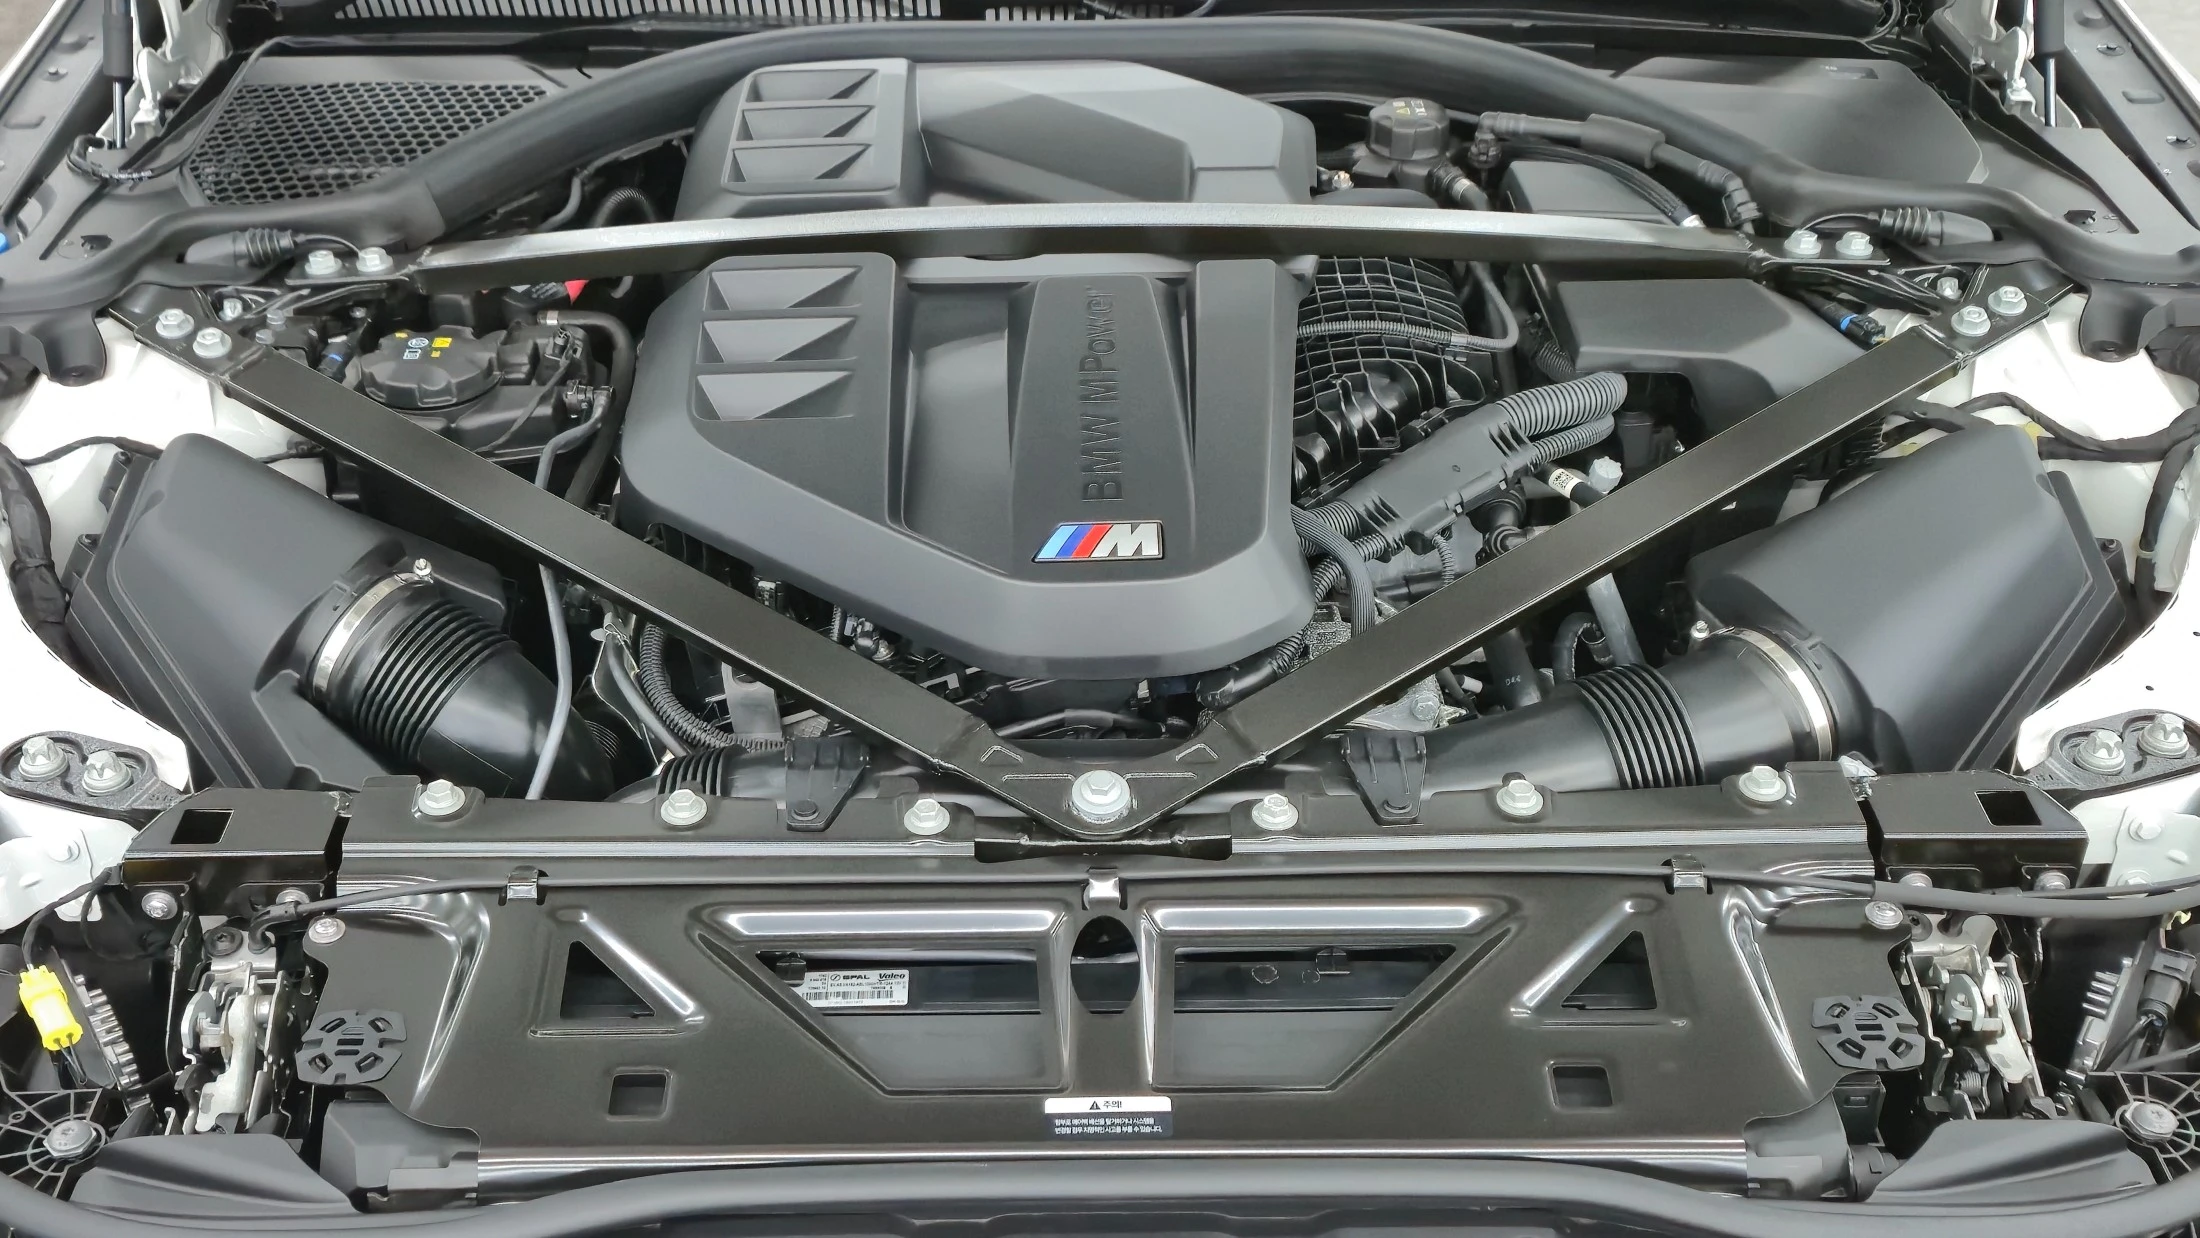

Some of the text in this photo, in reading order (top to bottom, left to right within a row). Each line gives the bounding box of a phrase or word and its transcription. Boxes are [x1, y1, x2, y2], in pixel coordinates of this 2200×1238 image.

[1081, 415, 1124, 501] BMW
[878, 972, 906, 980] Valeo
[1103, 1100, 1122, 1109] 주의!
[1133, 1117, 1154, 1125] 시스템을
[1105, 1125, 1121, 1133] 사고를
[1133, 1125, 1139, 1133] 수
[1140, 1125, 1162, 1133] 있습니다.
